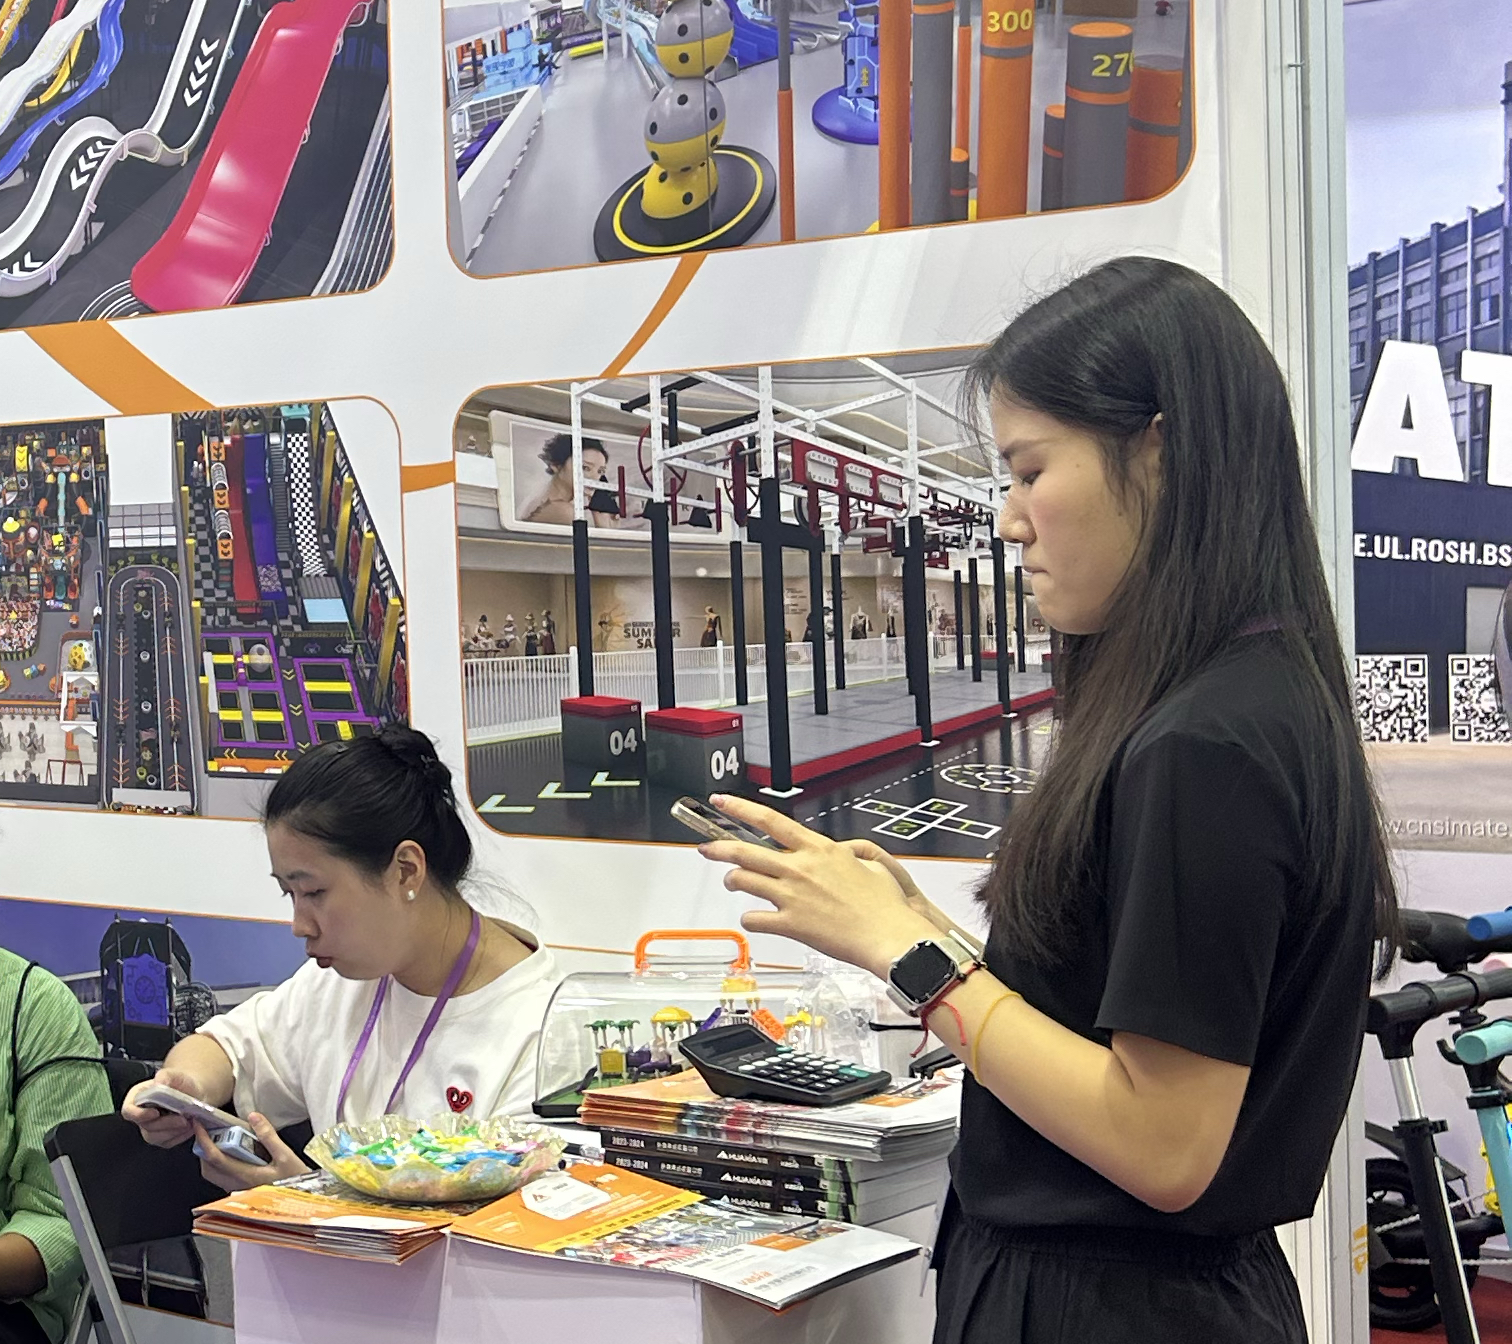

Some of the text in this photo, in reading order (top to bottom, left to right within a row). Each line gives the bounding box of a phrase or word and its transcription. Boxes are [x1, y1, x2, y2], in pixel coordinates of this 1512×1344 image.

[987, 8, 1033, 33] 300
[609, 726, 638, 757] 04
[710, 745, 740, 781] 04
